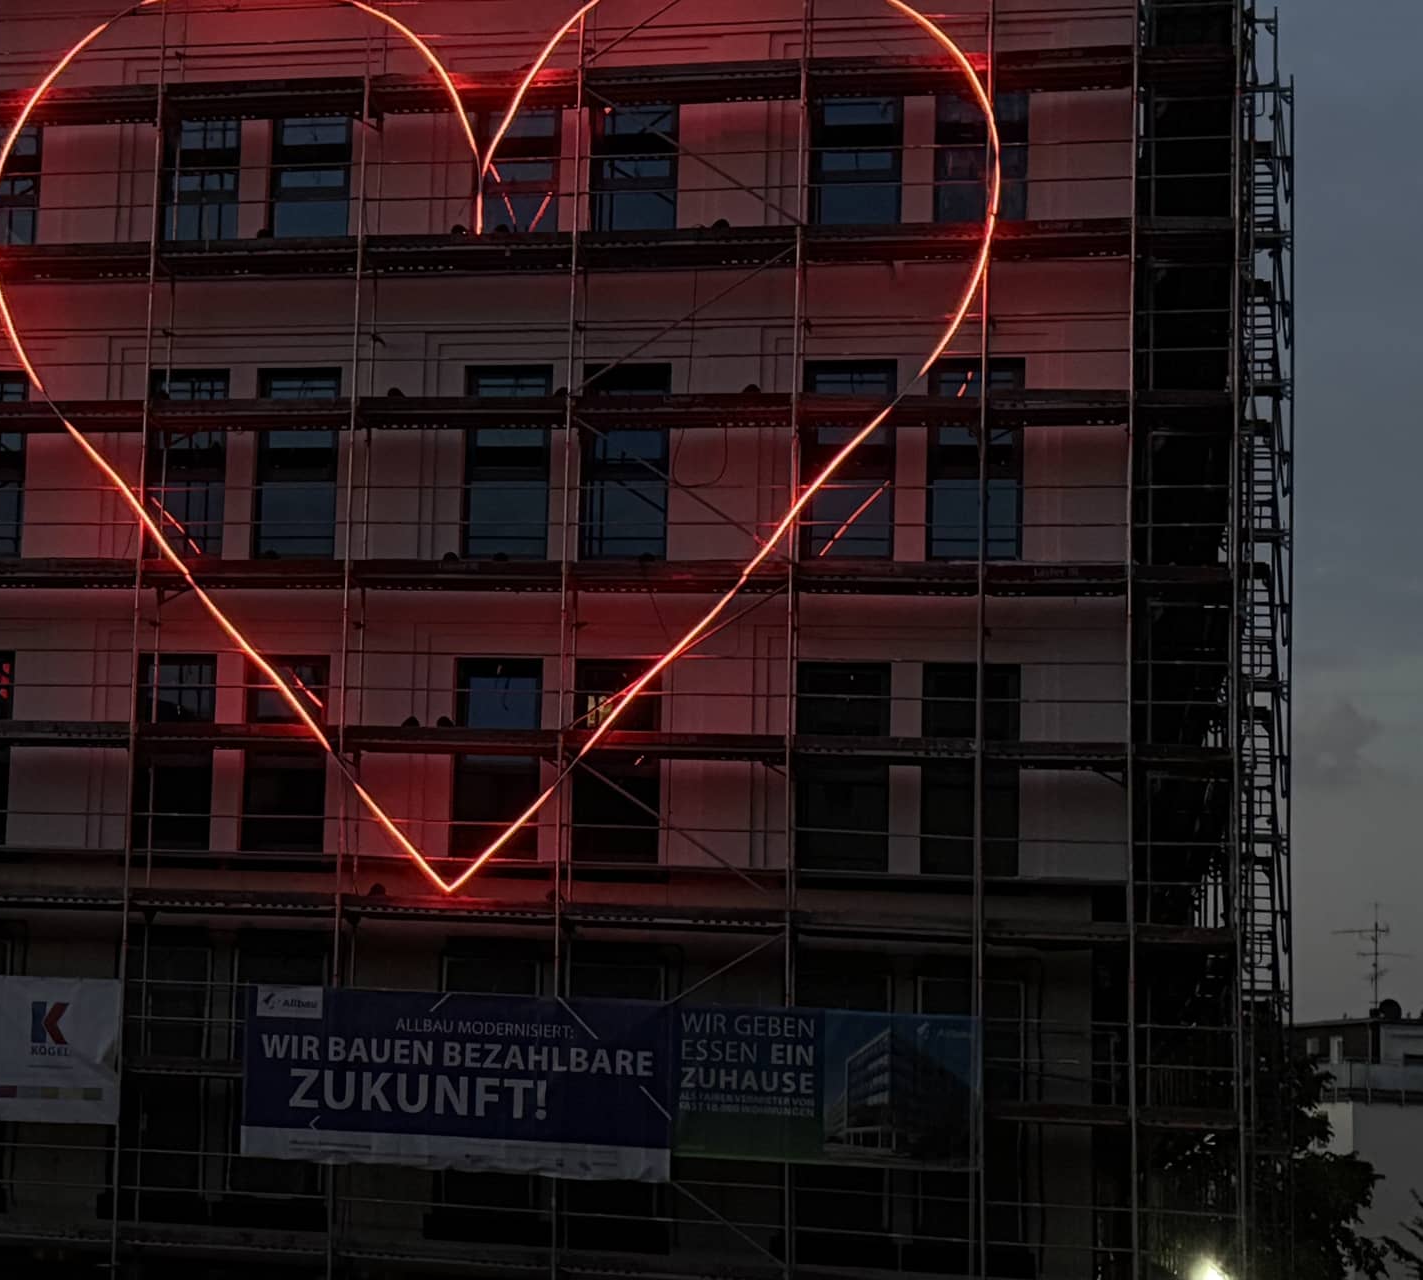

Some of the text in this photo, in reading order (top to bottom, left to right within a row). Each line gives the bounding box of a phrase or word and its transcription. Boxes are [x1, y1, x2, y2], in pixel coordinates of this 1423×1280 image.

[282, 999, 318, 1009] Allbau
[31, 1001, 70, 1044] K
[395, 1017, 575, 1040] ALLBAU MODERNISIERT:
[681, 1012, 815, 1038] WIR GEBEN
[261, 1034, 655, 1077] WIR BAUEN BEZAHLBARE
[681, 1039, 815, 1066] ESSEN EIN
[680, 1067, 815, 1094] ZUHAUSE
[288, 1068, 548, 1121] ZUKUNFT!
